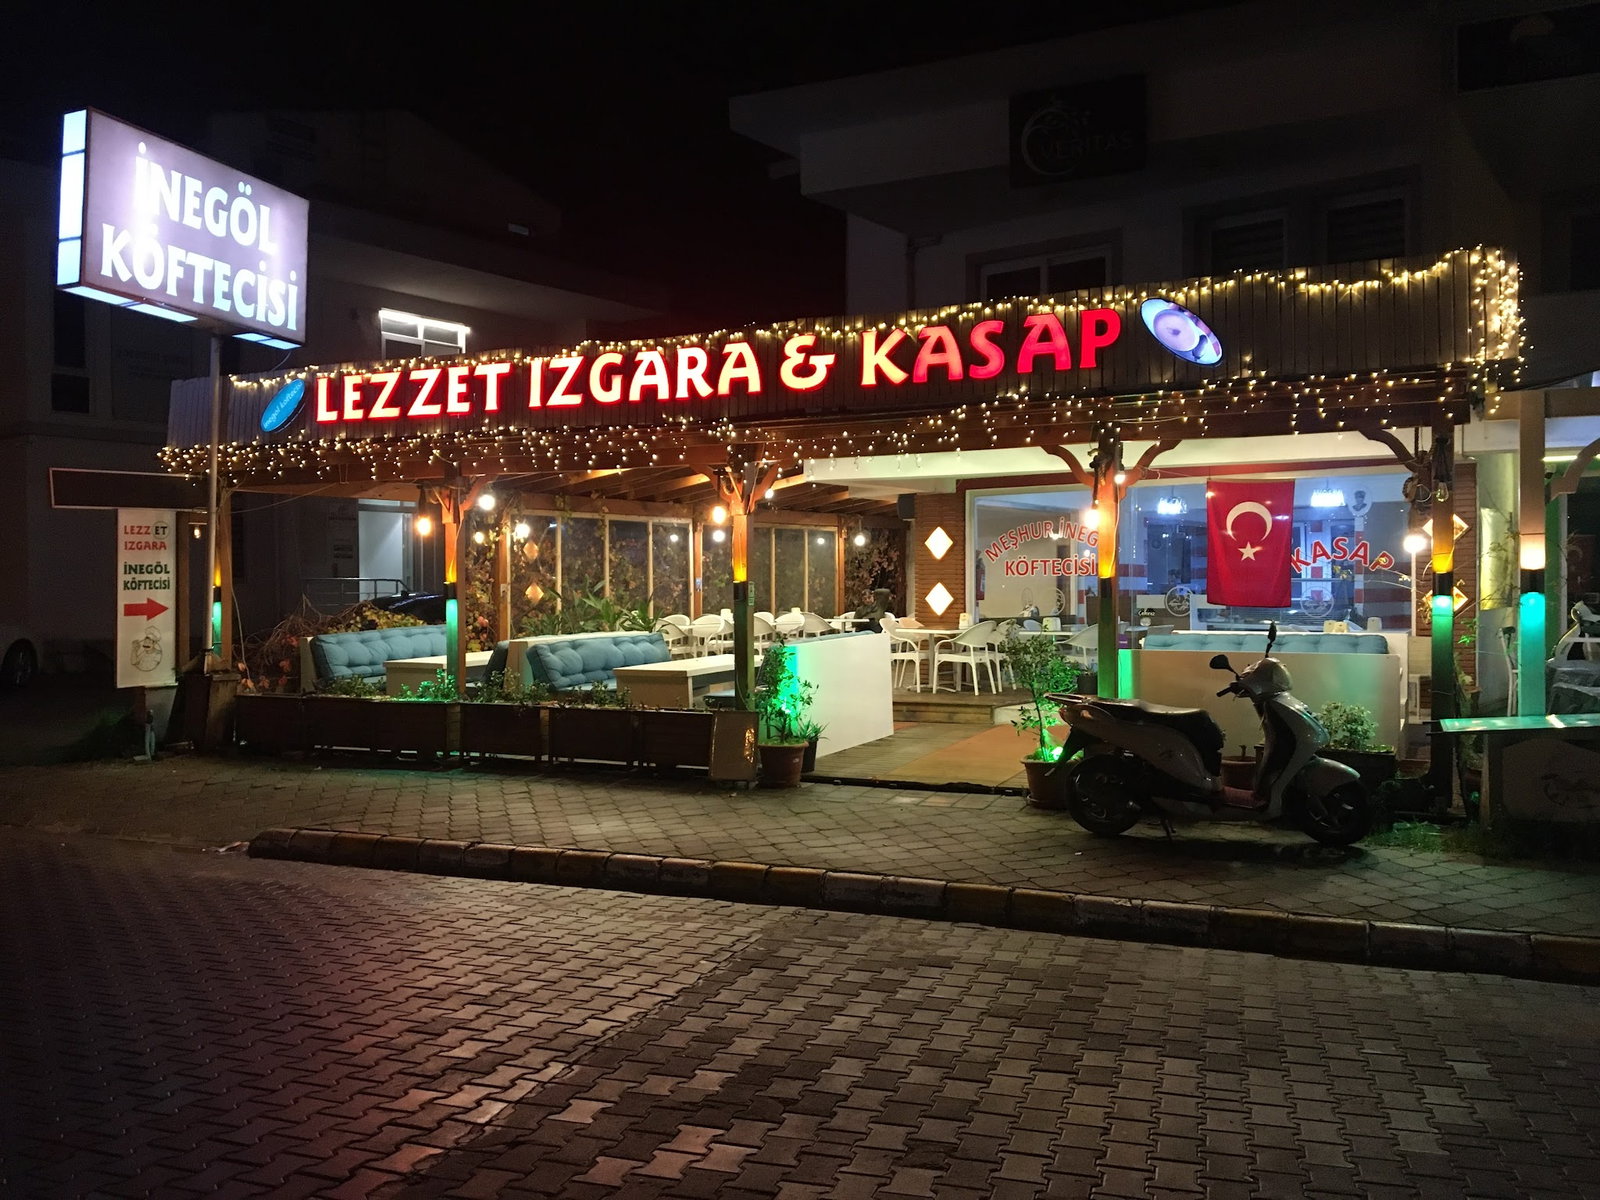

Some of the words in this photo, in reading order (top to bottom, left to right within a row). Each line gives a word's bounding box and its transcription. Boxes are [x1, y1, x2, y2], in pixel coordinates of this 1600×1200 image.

[135, 141, 279, 255] İNEGÖL
[101, 222, 298, 331] KÖFTECİSİ
[316, 362, 511, 423] LEZZET
[527, 341, 762, 408] IZGARA
[779, 334, 837, 390] &
[861, 308, 1121, 386] KASAP
[124, 541, 167, 550] IZGARA
[984, 520, 1054, 562] MEŞHUR
[1058, 516, 1099, 548] İNEG
[1290, 536, 1395, 574] KASAP
[123, 561, 170, 575] İNEGÖL
[123, 577, 171, 590] KÖFTECİSİ
[1004, 554, 1097, 577] KÖFTECİSİ
